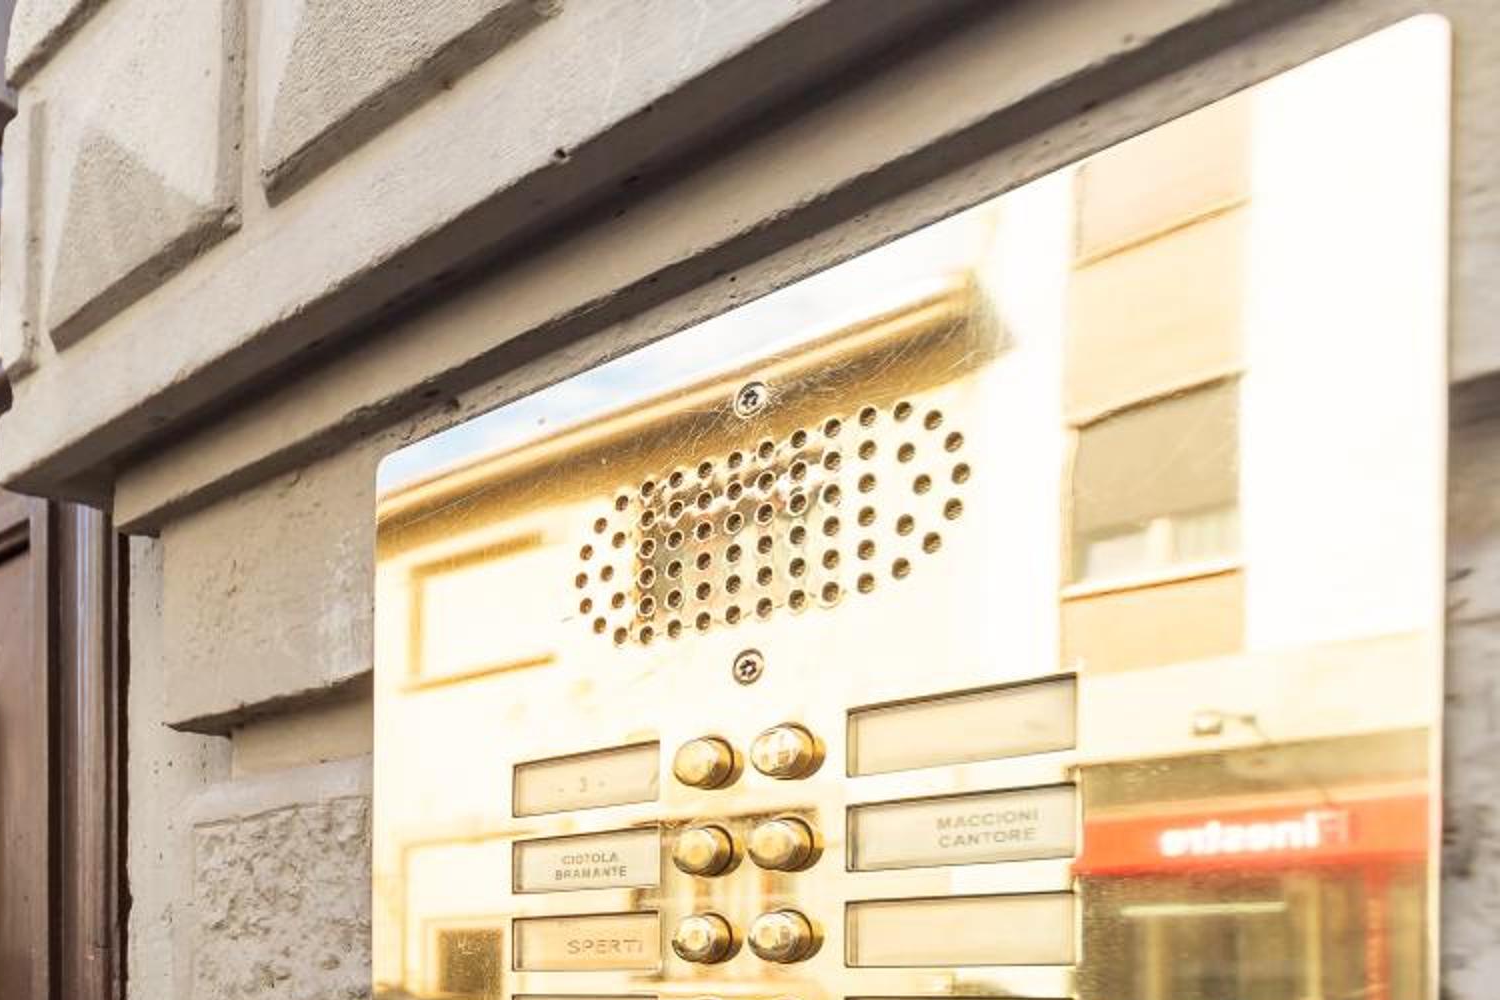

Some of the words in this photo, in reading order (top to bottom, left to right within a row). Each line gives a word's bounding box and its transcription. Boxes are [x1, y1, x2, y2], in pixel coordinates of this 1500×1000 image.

[937, 808, 1038, 829] MACCIONI
[937, 828, 1037, 848] CANTORE
[554, 866, 628, 880] BRAMANTE
[567, 939, 643, 954] SPERTI
